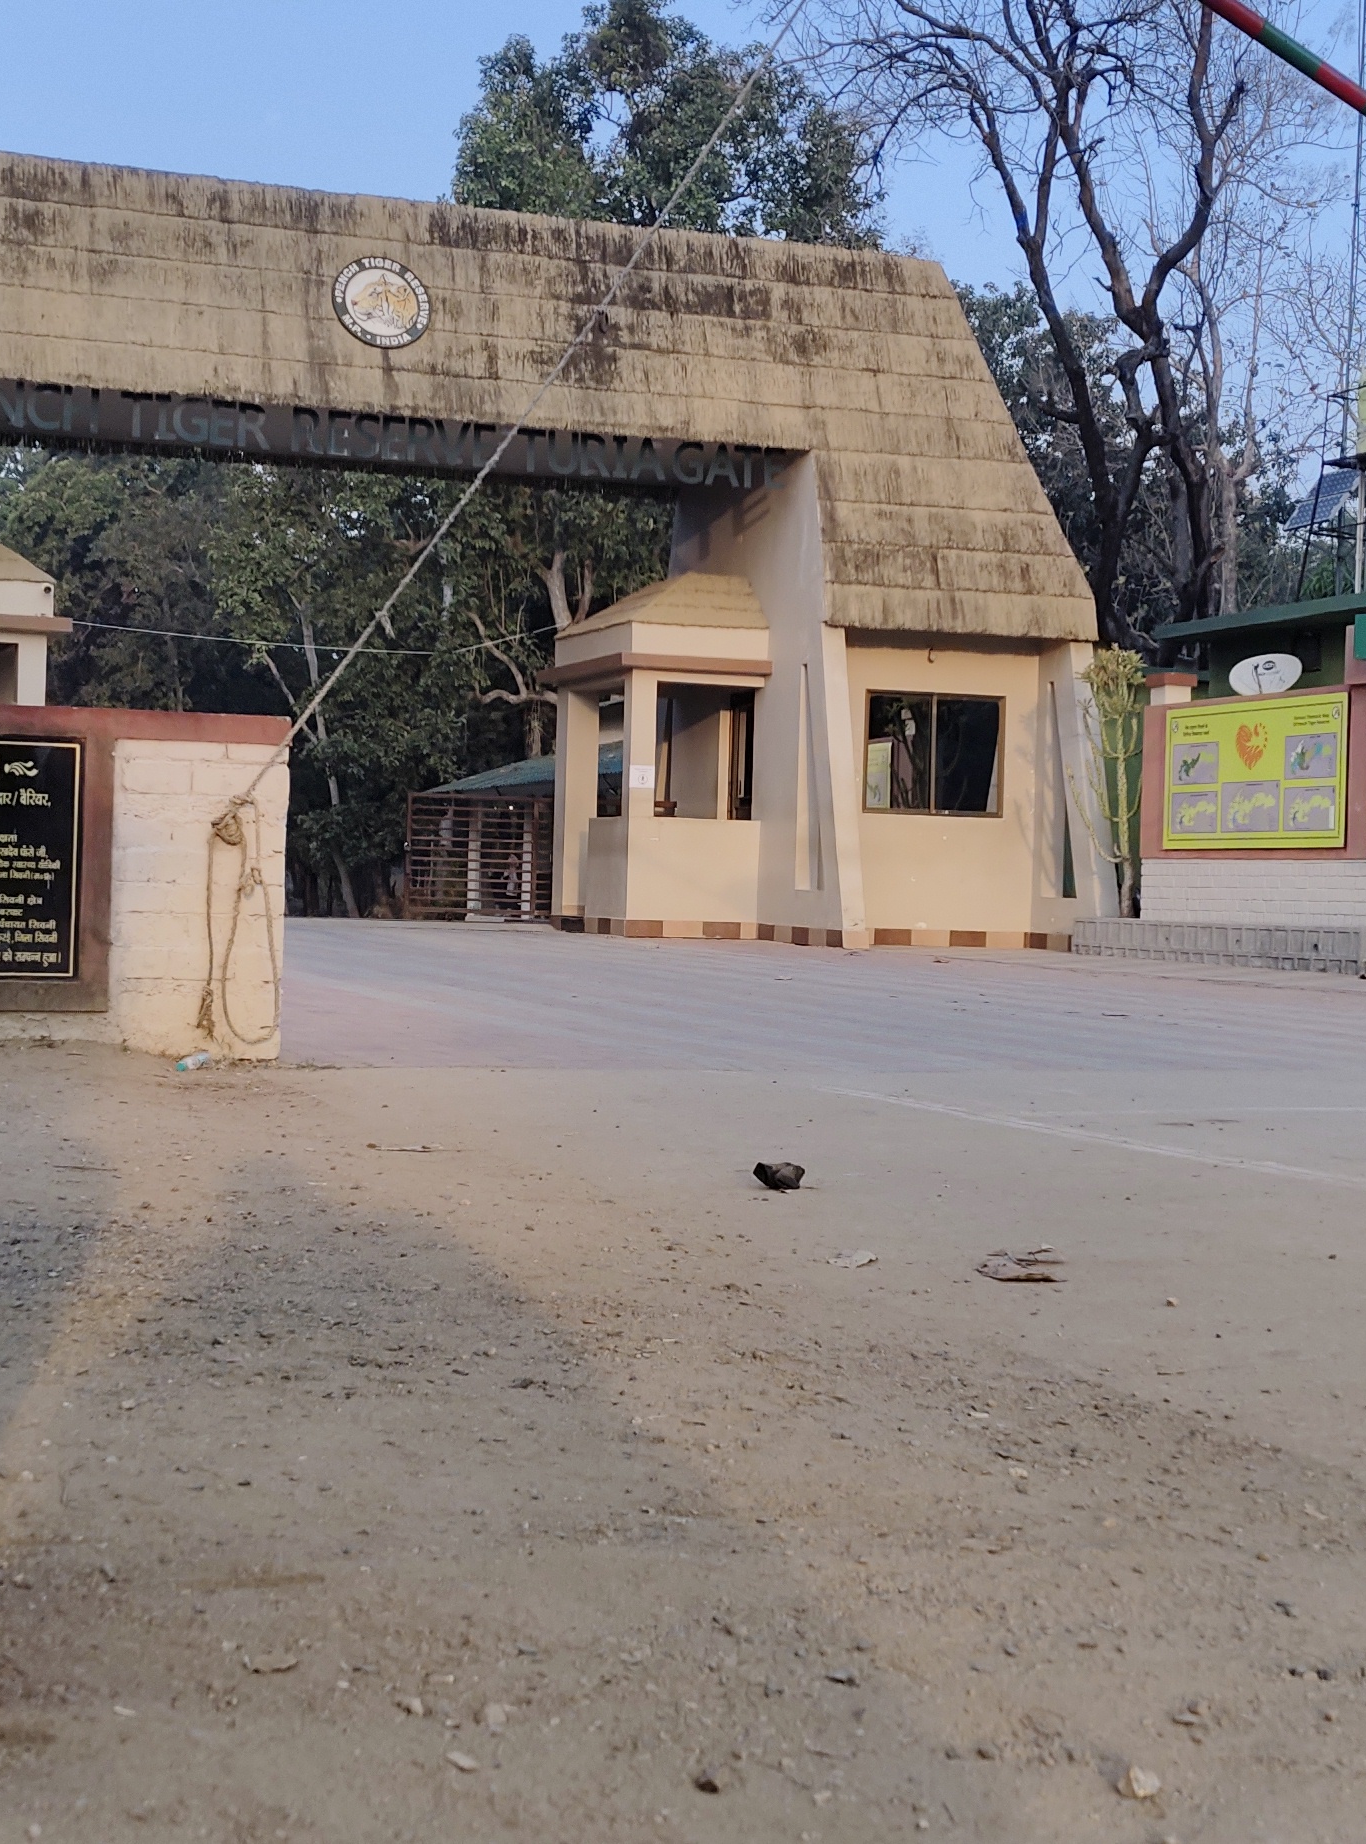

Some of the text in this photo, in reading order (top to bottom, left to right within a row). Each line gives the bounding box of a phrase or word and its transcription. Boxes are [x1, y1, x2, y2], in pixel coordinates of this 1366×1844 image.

[335, 257, 430, 326] PENCH TIGER RESERVE
[376, 333, 412, 346] INDIA
[120, 391, 271, 451] TIGER
[291, 406, 495, 467] RESERVE
[516, 427, 670, 480] TURIA
[671, 440, 787, 490] GATE
